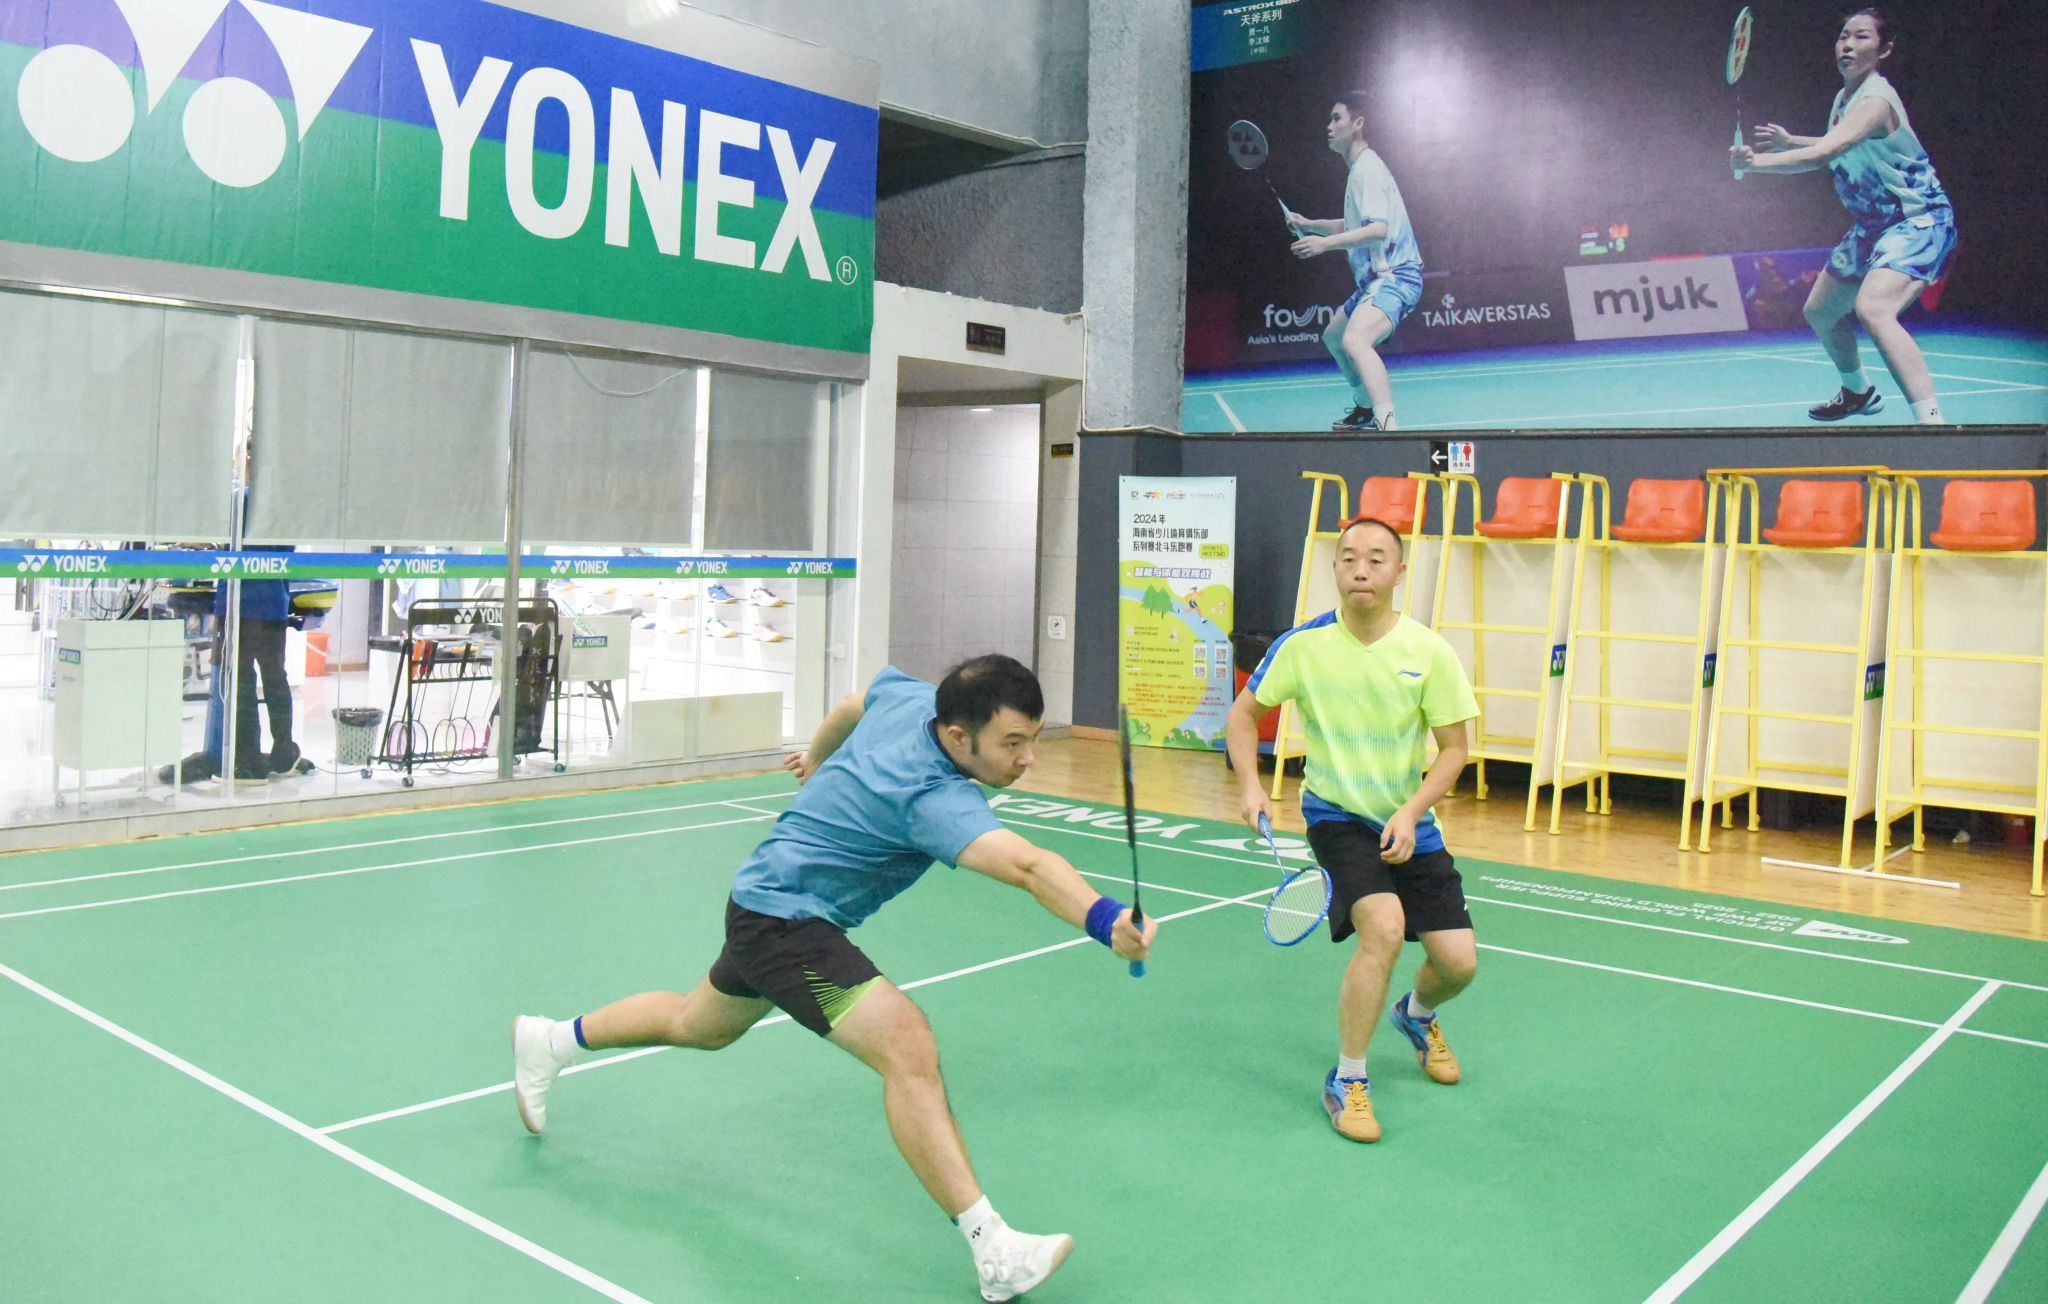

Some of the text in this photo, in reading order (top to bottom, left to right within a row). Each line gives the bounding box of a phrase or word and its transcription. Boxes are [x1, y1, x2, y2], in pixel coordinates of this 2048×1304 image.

[1240, 8, 1282, 27] 天斧系列
[409, 37, 837, 282] YONEX
[1593, 276, 1718, 322] mjuk
[1263, 303, 1333, 328] foun
[1422, 302, 1551, 328] TAIKAVERSTAS
[1278, 332, 1319, 343] Leading
[1133, 513, 1166, 524] 2024 年
[1132, 527, 1209, 540] 海南省少儿体育俱乐部
[53, 555, 108, 573] YONEX
[241, 557, 289, 574] YONEX
[404, 558, 446, 575] YONEX
[573, 559, 610, 575] YONEX
[695, 561, 729, 575] YONEX
[804, 561, 833, 575] YONEX
[586, 637, 606, 647] YONEX
[1478, 875, 1794, 927] OF BWF WORLD CHAMPIONSHIPS
[1495, 883, 1785, 932] OFFICIAL FLOORING SUPPLIER
[1755, 912, 1802, 922] 2022
